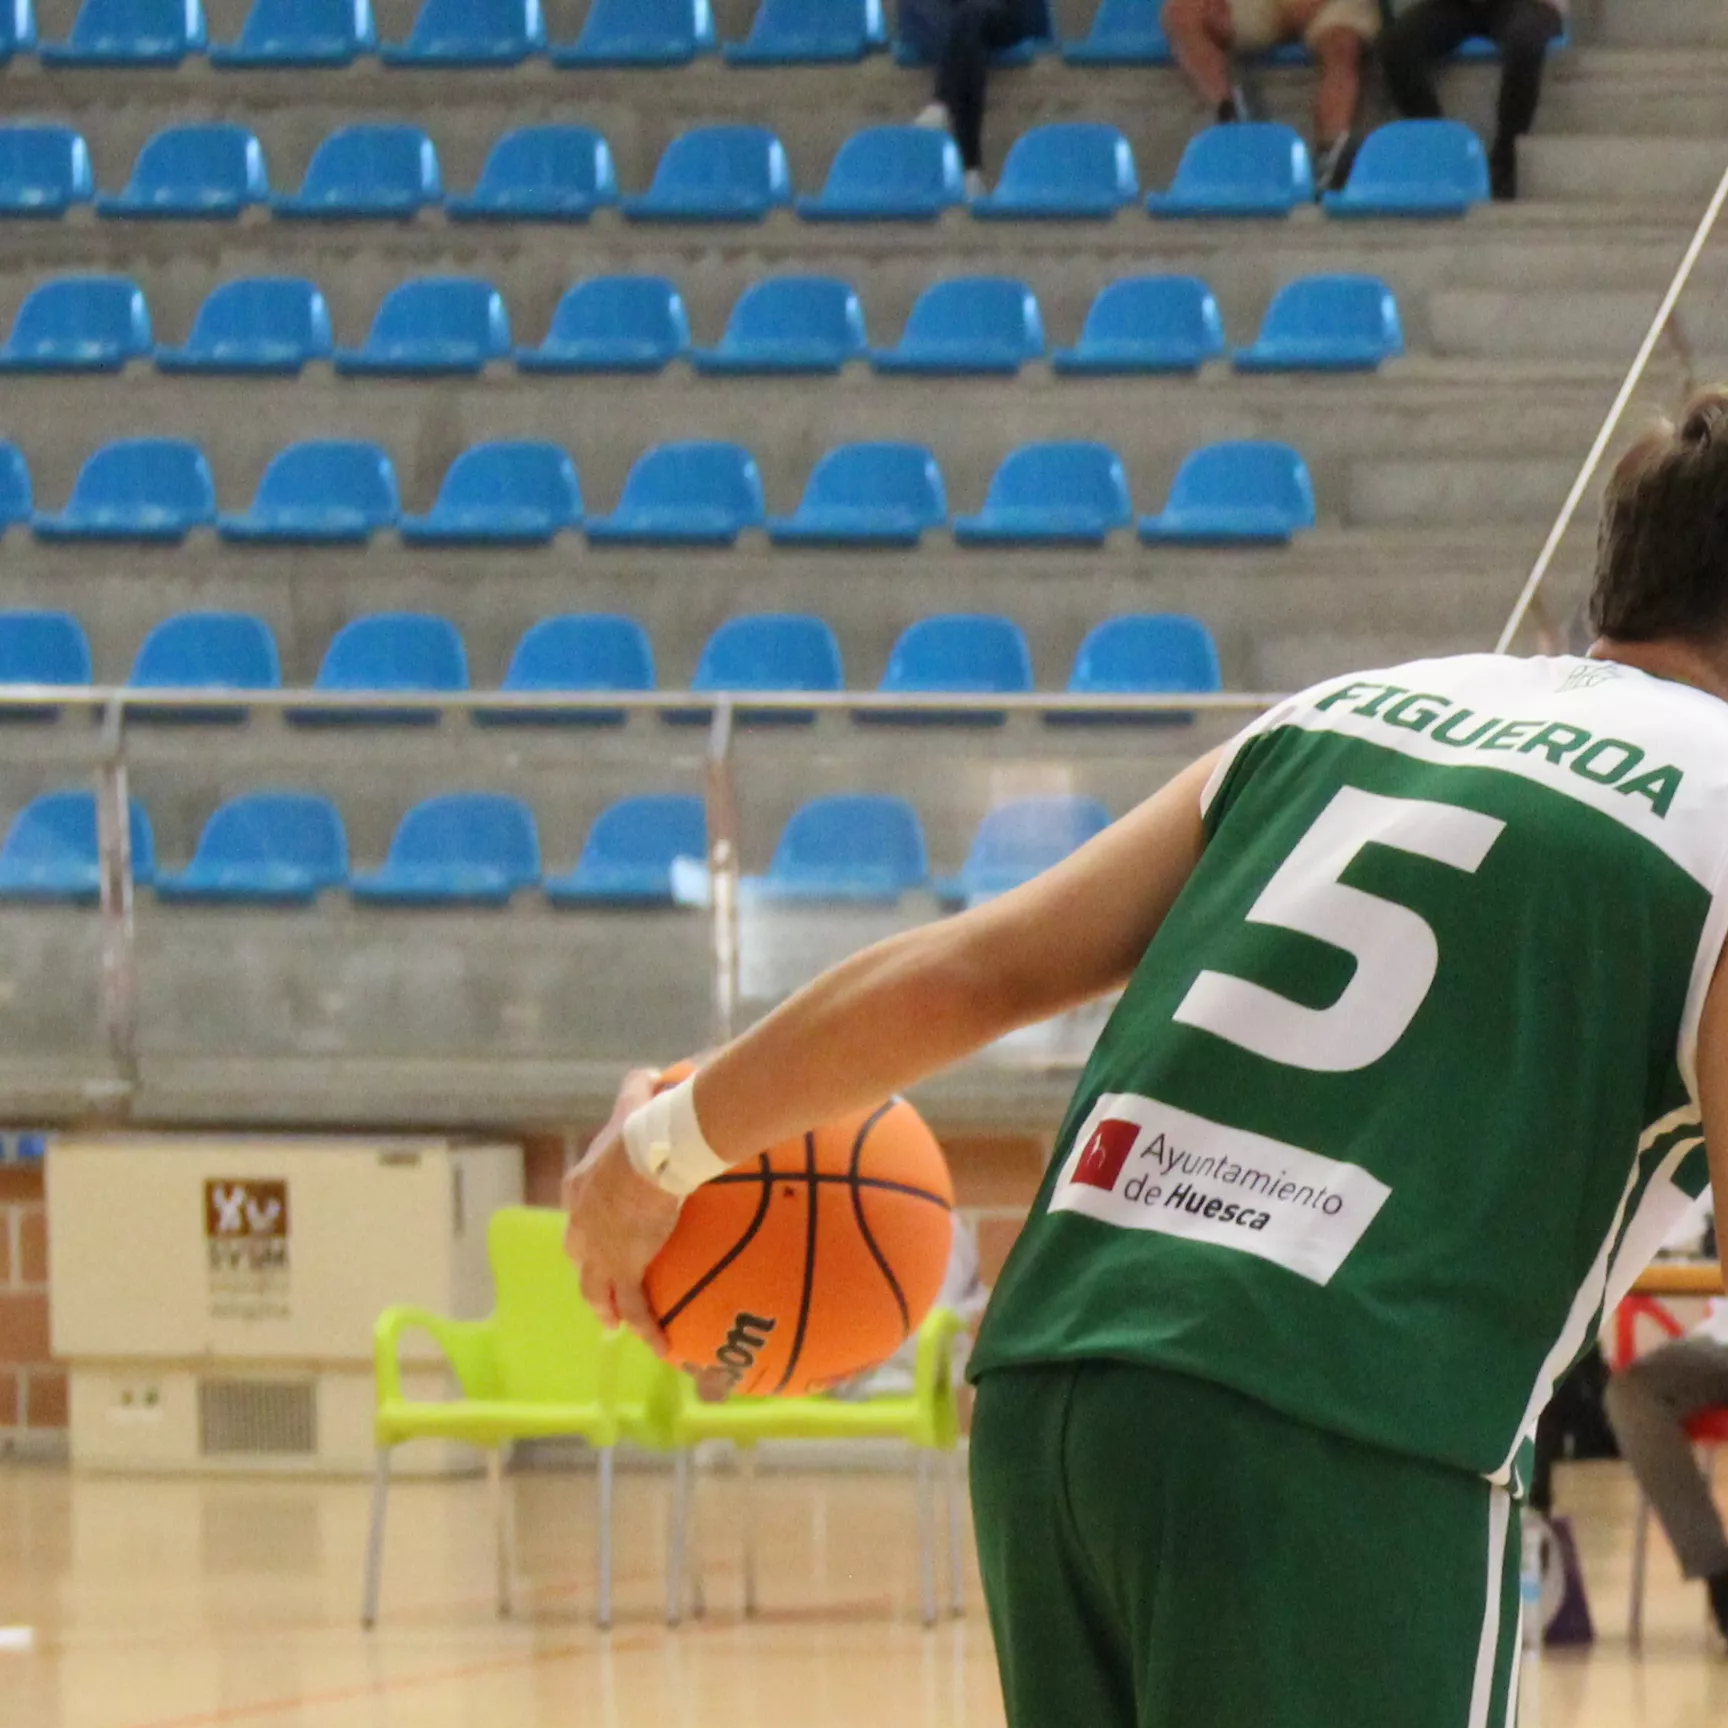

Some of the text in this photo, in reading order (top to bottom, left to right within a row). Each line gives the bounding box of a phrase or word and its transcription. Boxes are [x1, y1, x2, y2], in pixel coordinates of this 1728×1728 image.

[1314, 682, 1684, 819] FIGUEROA
[1172, 785, 1506, 1073] 5
[1123, 1173, 1271, 1231] de Huesca
[1141, 1132, 1343, 1216] Ayuntamiento
